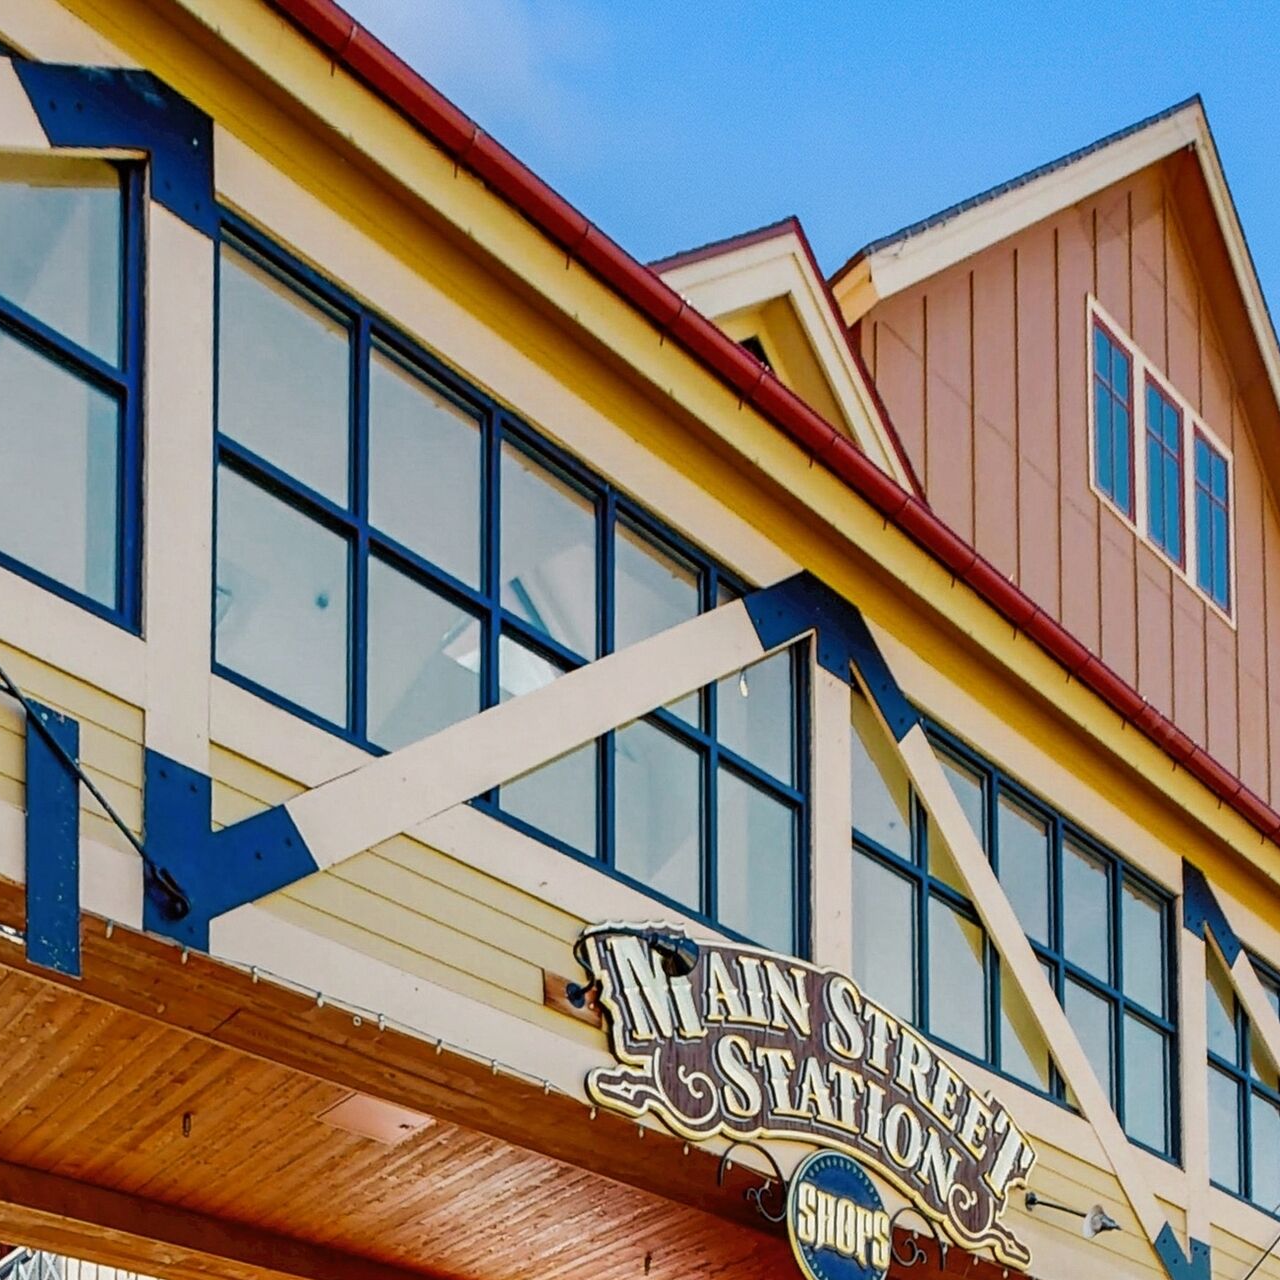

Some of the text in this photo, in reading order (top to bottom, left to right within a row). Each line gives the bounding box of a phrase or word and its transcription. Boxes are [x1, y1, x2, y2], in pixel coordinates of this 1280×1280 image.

[606, 935, 1036, 1200] MAIN STREET
[715, 1034, 960, 1204] STATION
[797, 1182, 891, 1271] SHOPS
